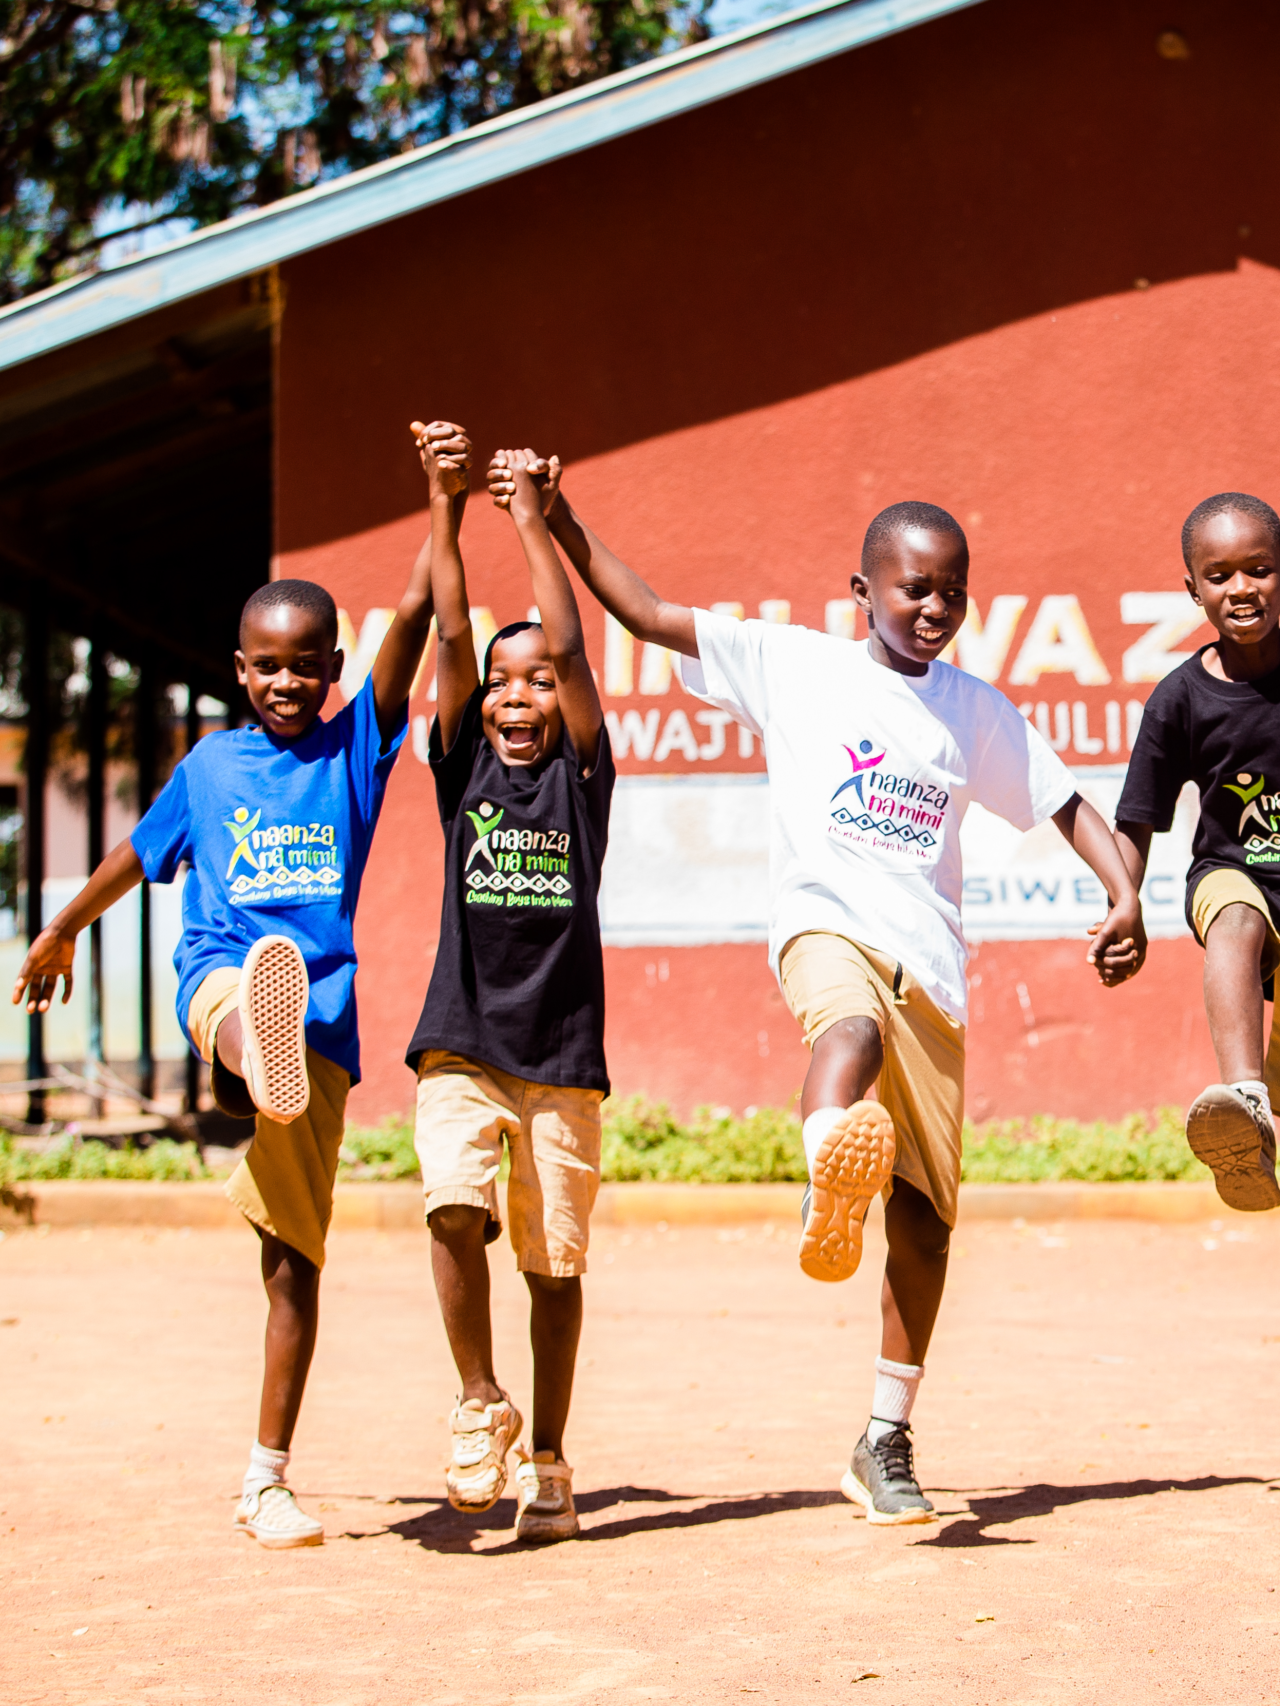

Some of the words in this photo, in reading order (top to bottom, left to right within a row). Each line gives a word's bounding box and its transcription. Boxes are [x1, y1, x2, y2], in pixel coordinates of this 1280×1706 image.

[869, 771, 949, 810] naanza
[868, 795, 896, 817] na
[899, 804, 945, 830] mimi
[252, 823, 335, 850] naanza
[491, 829, 570, 854] naanza
[258, 847, 284, 870] na
[288, 846, 337, 866] mimi
[497, 852, 522, 872] na
[526, 852, 569, 874] mimi
[466, 889, 505, 906] Coaching
[506, 892, 531, 907] Boys
[531, 894, 551, 907] Into
